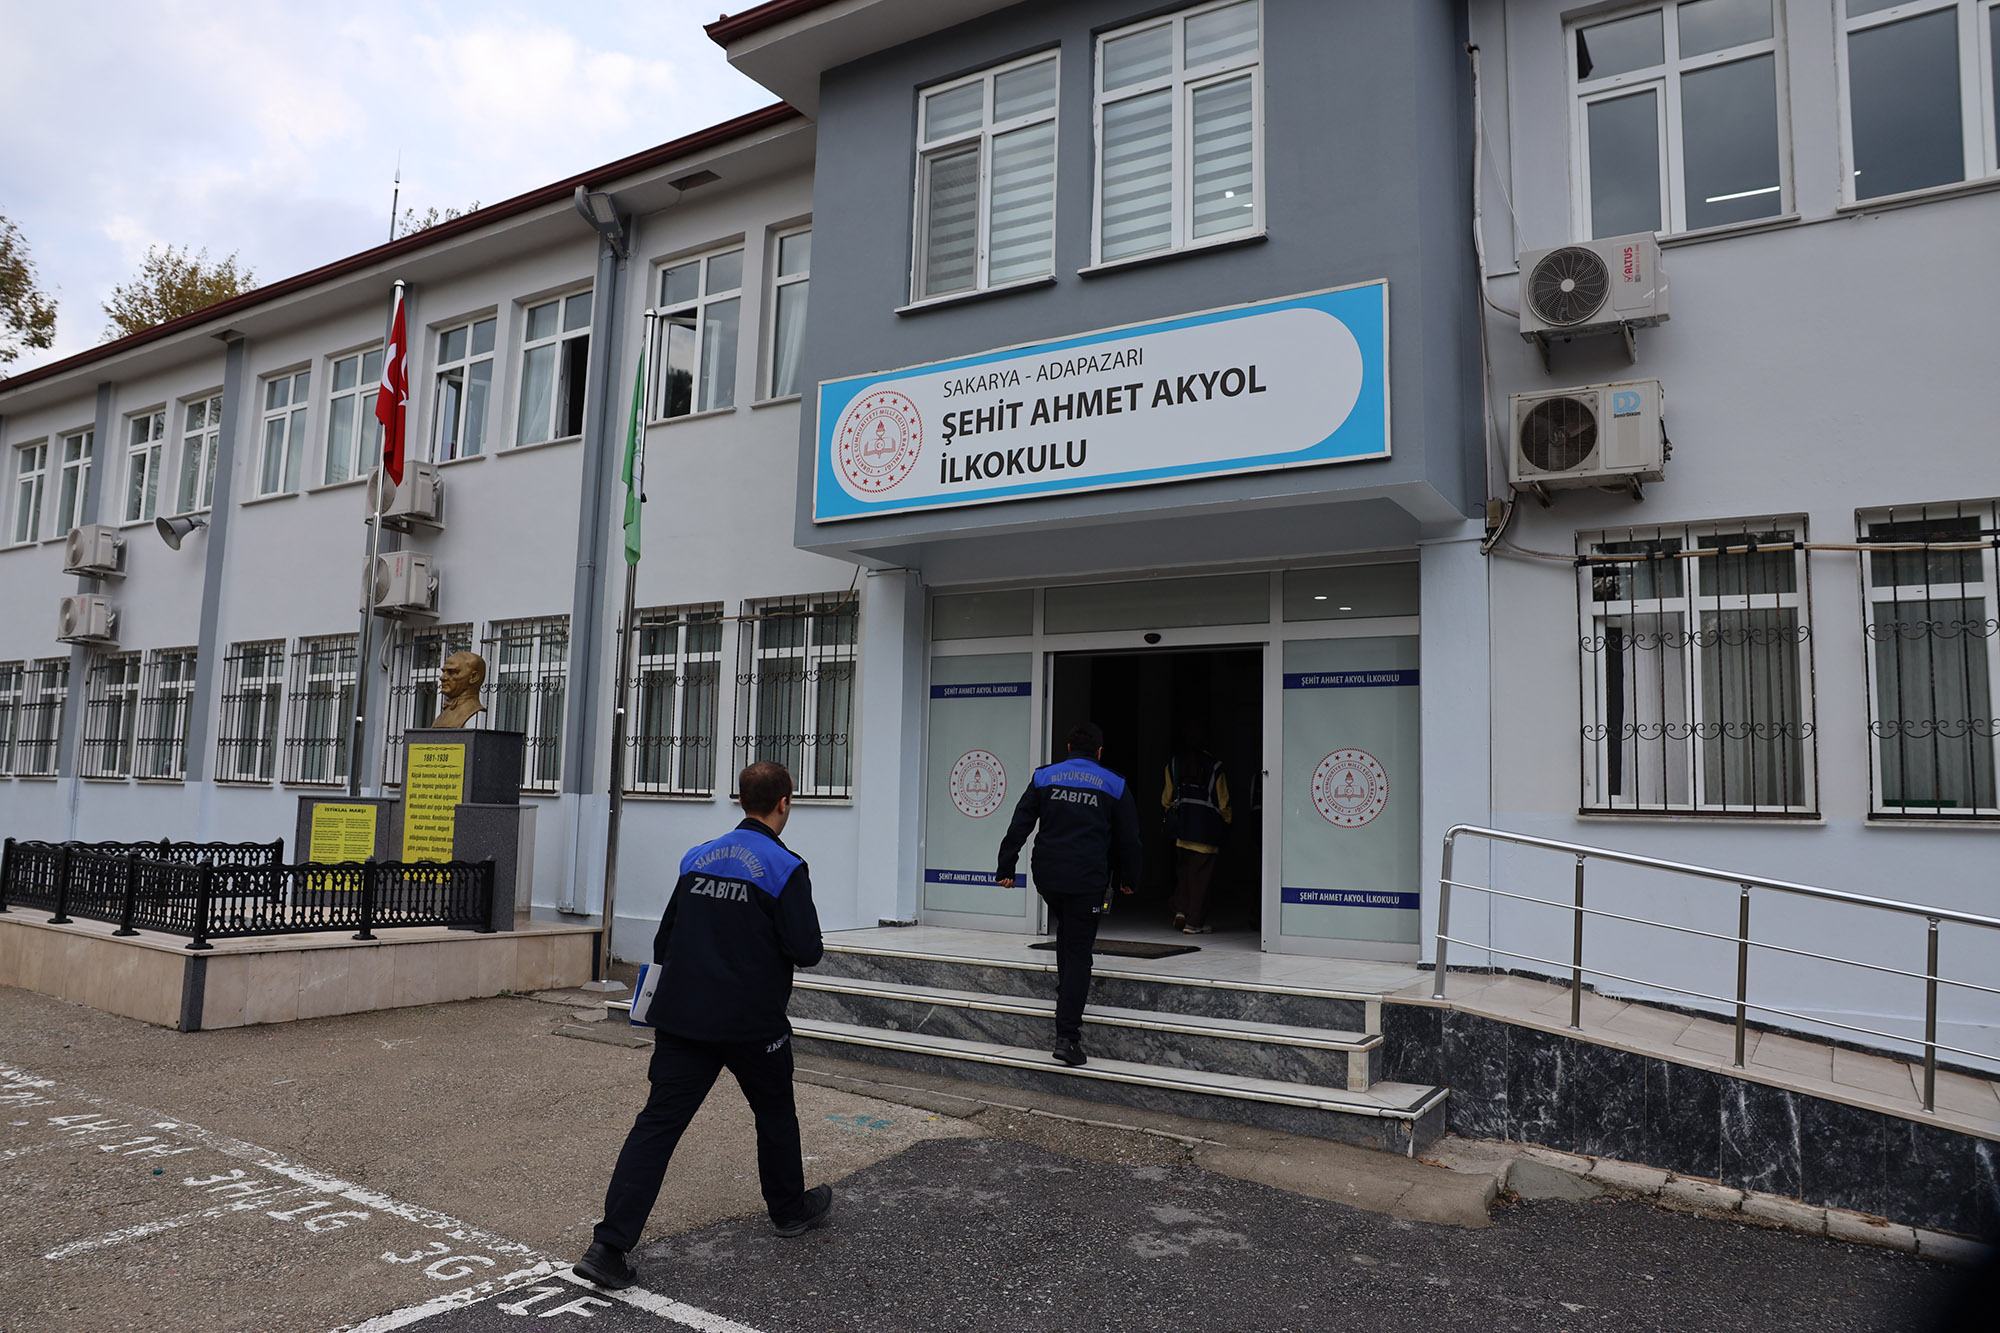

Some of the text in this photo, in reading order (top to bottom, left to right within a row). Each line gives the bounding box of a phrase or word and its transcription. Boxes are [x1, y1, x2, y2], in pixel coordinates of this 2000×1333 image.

[1624, 246, 1633, 274] ALTUS
[943, 369, 1020, 398] SAKARYA
[1036, 347, 1144, 382] ADAPAZARI
[942, 364, 1267, 445] ŞEHİT AHMET AKYOL
[940, 439, 1087, 484] İLKOKULU
[944, 686, 958, 696] ŞEHİT
[992, 685, 1018, 694] İLKOKULU
[1301, 673, 1400, 686] ŞEHİT AHMET AKYOL İLKOKULU
[424, 754, 449, 762] 1881-1938
[1051, 769, 1104, 788] BÜYÜKŞEHİR
[1050, 788, 1098, 807] ZABITA
[695, 844, 766, 878] SAKARYA BÜYÜKŞEHİR
[690, 877, 748, 902] ZABITA
[939, 872, 953, 882] ŞEHİT
[953, 874, 970, 882] AHMET
[1300, 890, 1400, 904] ŞEHİT AHMET AKYOL İLKOKULU
[182, 1168, 284, 1198] 3H
[266, 1200, 371, 1234] 1G
[379, 1242, 497, 1281] 3G
[497, 1286, 614, 1318] 1F
